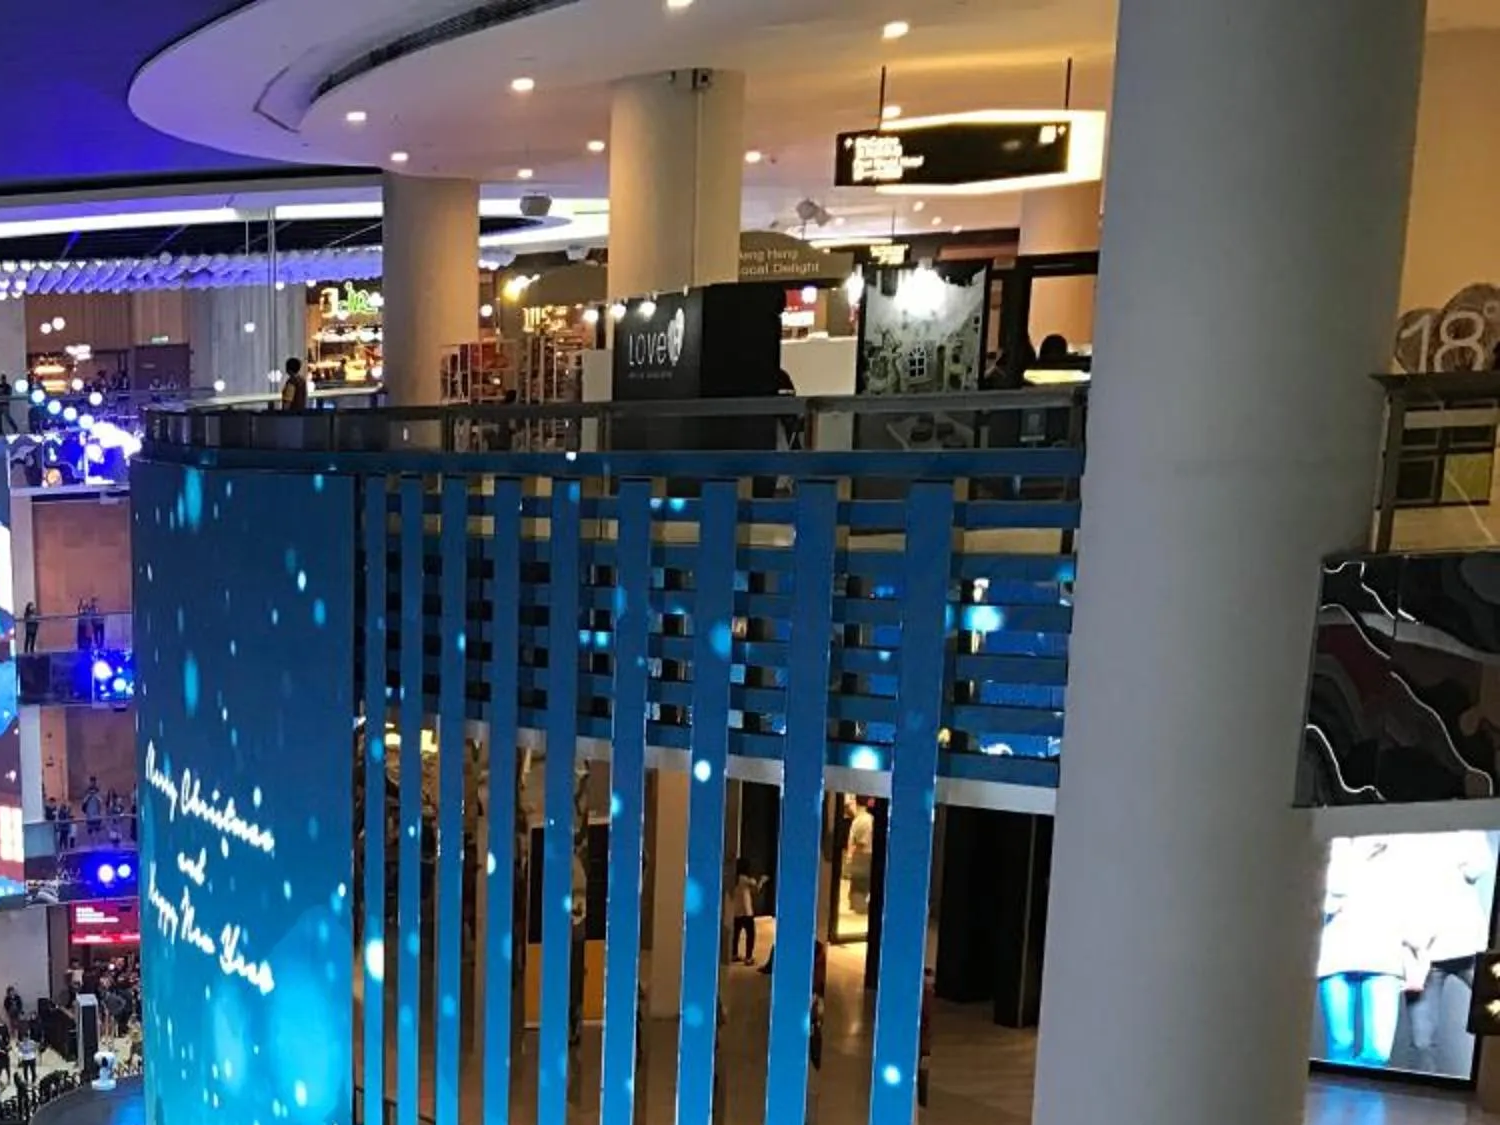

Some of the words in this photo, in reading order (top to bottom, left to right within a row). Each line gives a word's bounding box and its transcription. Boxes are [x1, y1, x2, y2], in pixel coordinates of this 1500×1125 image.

[740, 263, 768, 275] ocal
[177, 847, 206, 886] and
[180, 885, 216, 954] New
